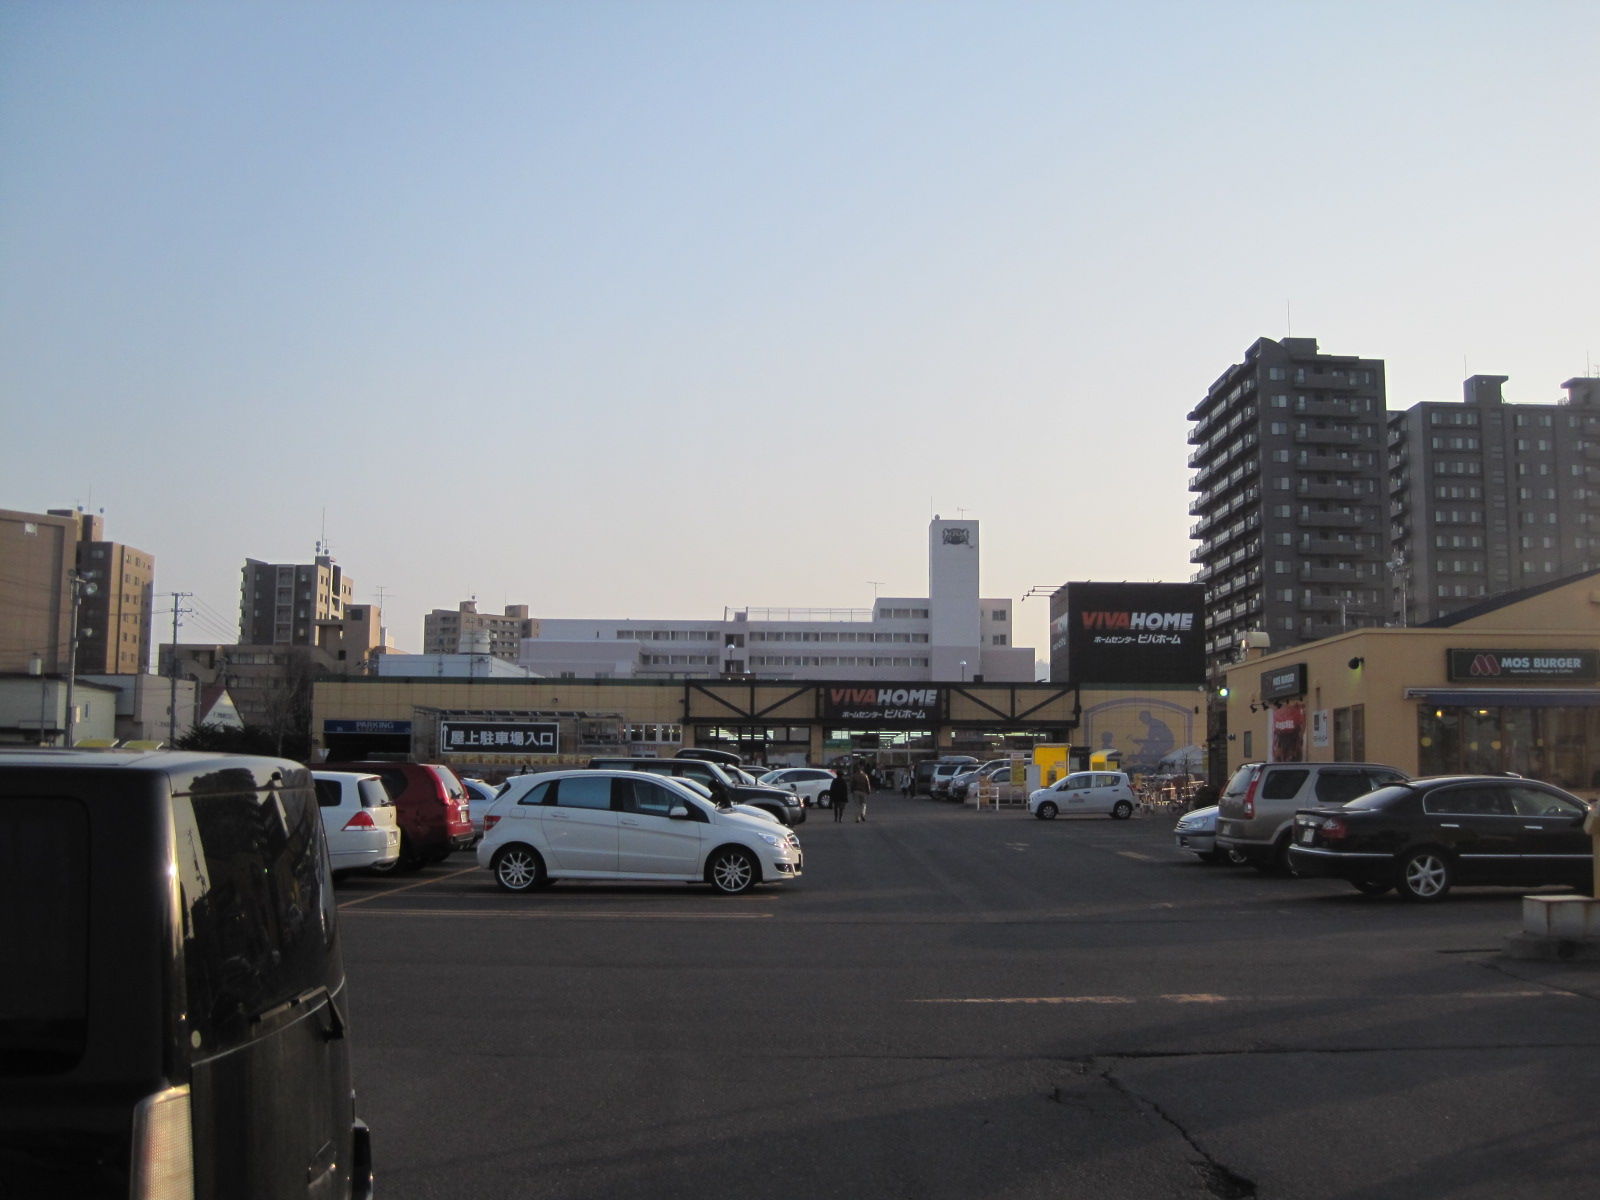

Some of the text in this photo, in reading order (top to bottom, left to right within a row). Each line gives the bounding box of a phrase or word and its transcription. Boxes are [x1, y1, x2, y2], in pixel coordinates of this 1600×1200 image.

[1094, 634, 1181, 644] ホームセンター ビバホーム
[1501, 657, 1582, 668] MOS BURGER
[842, 709, 926, 719] ホームセンター ビバホーム
[355, 721, 394, 729] PARKING
[450, 730, 554, 746] 屋上駐車場入口
